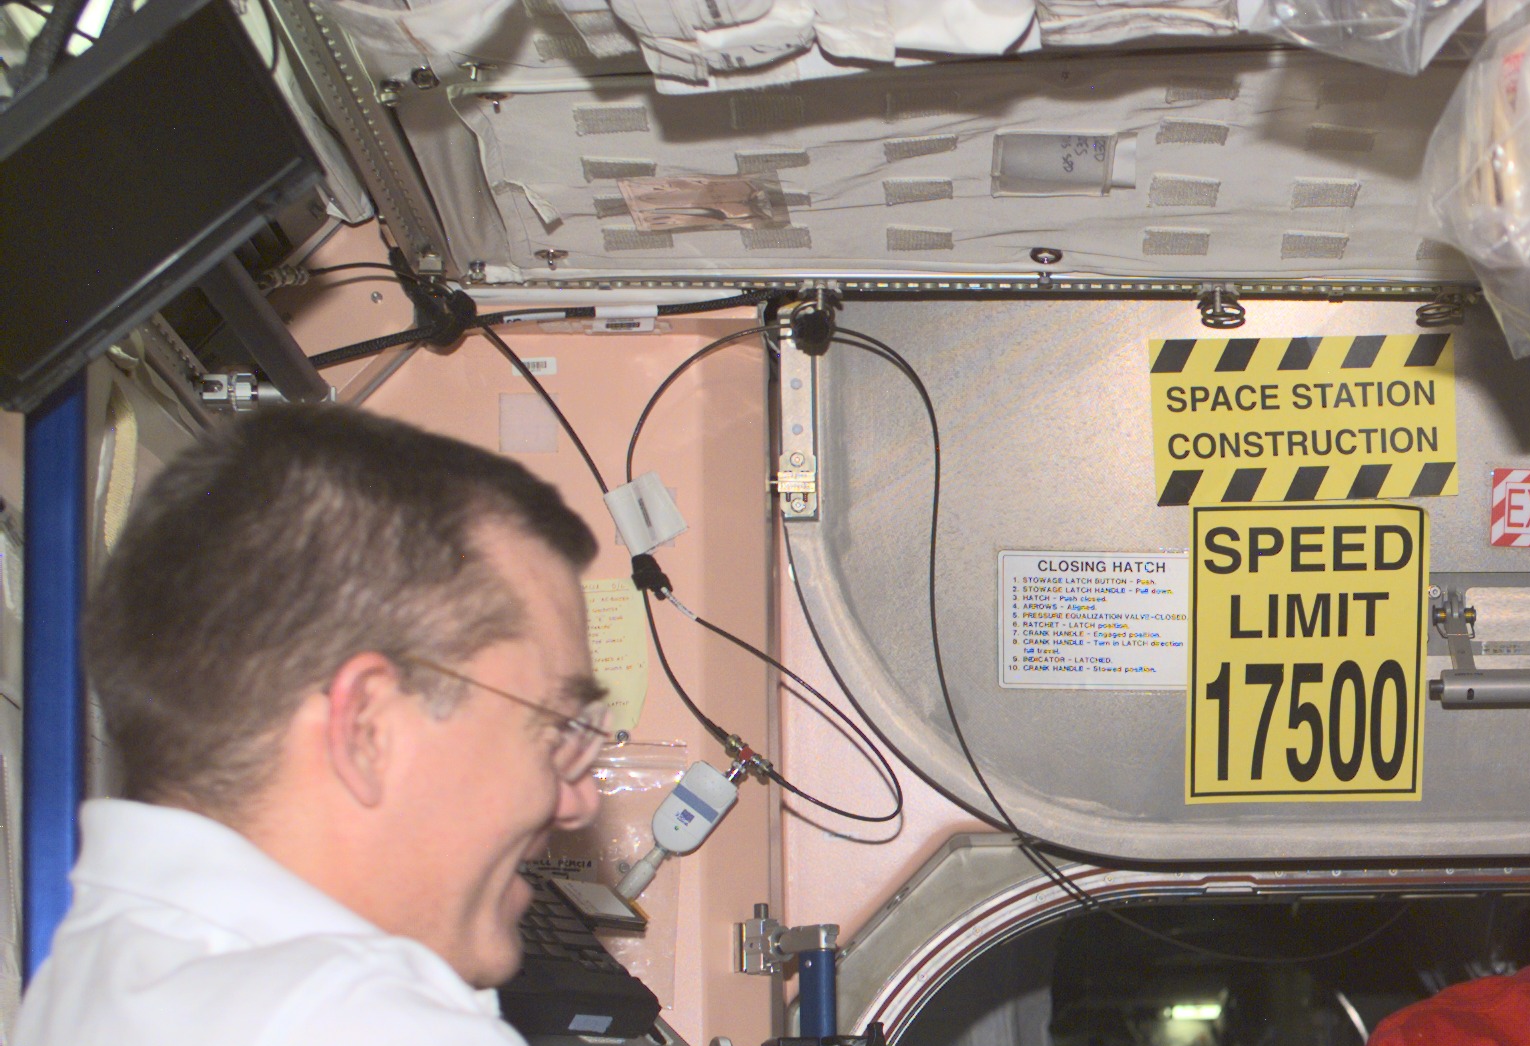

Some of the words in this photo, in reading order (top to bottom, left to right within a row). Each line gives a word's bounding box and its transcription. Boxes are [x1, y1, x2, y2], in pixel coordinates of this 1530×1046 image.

[1166, 384, 1280, 412] SPACE
[1292, 380, 1436, 410] STATION
[1167, 426, 1438, 460] CONSTRUCTION
[1037, 560, 1107, 573] CLOSING
[1112, 561, 1166, 573] HATCH
[1203, 525, 1413, 575] SPEED
[1230, 592, 1390, 639] LIMIT
[1206, 659, 1408, 783] 17500
